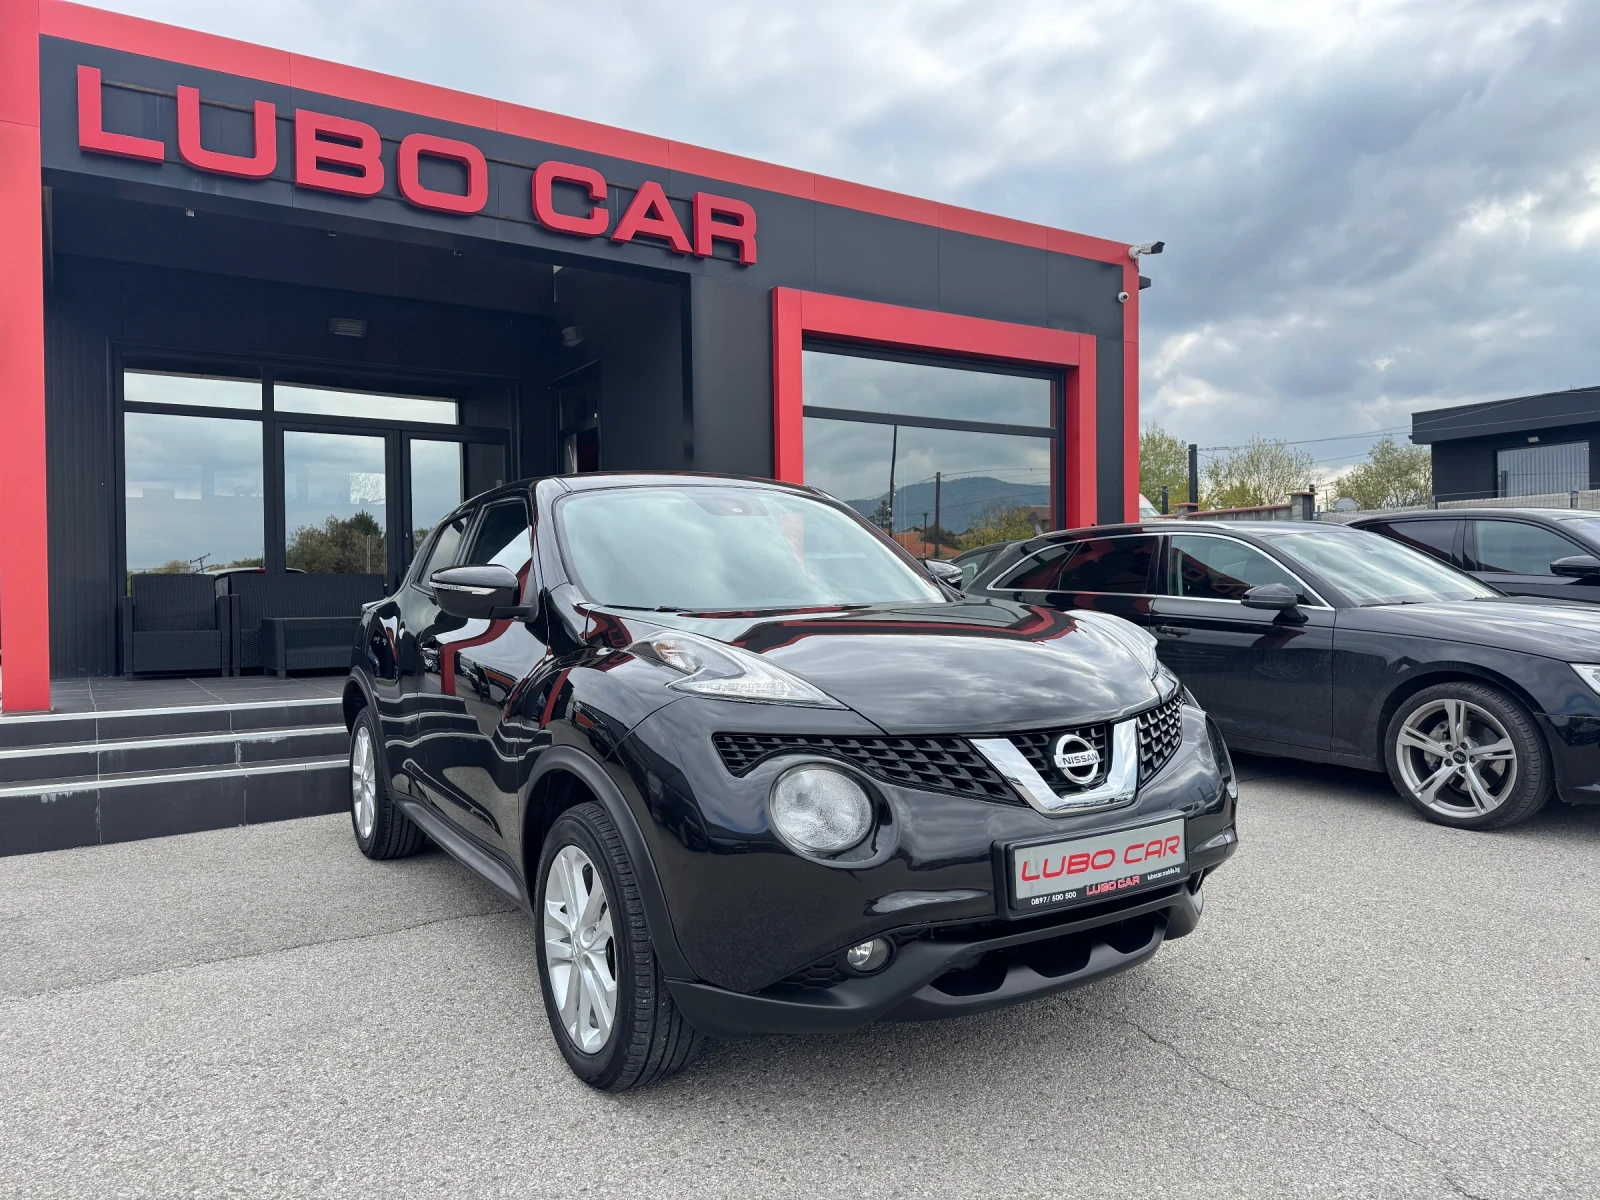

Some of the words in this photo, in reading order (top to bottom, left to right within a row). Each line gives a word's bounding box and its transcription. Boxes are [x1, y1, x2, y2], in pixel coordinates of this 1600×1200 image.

[77, 65, 489, 214] LUBO
[531, 161, 758, 265] CAR
[1062, 753, 1098, 765] NISSAN
[1021, 849, 1116, 882] LUBO
[1123, 835, 1180, 865] CAR
[1052, 893, 1064, 902] 500
[1065, 891, 1077, 899] 500
[1086, 881, 1116, 896] LUBO
[1117, 875, 1140, 889] CAR
